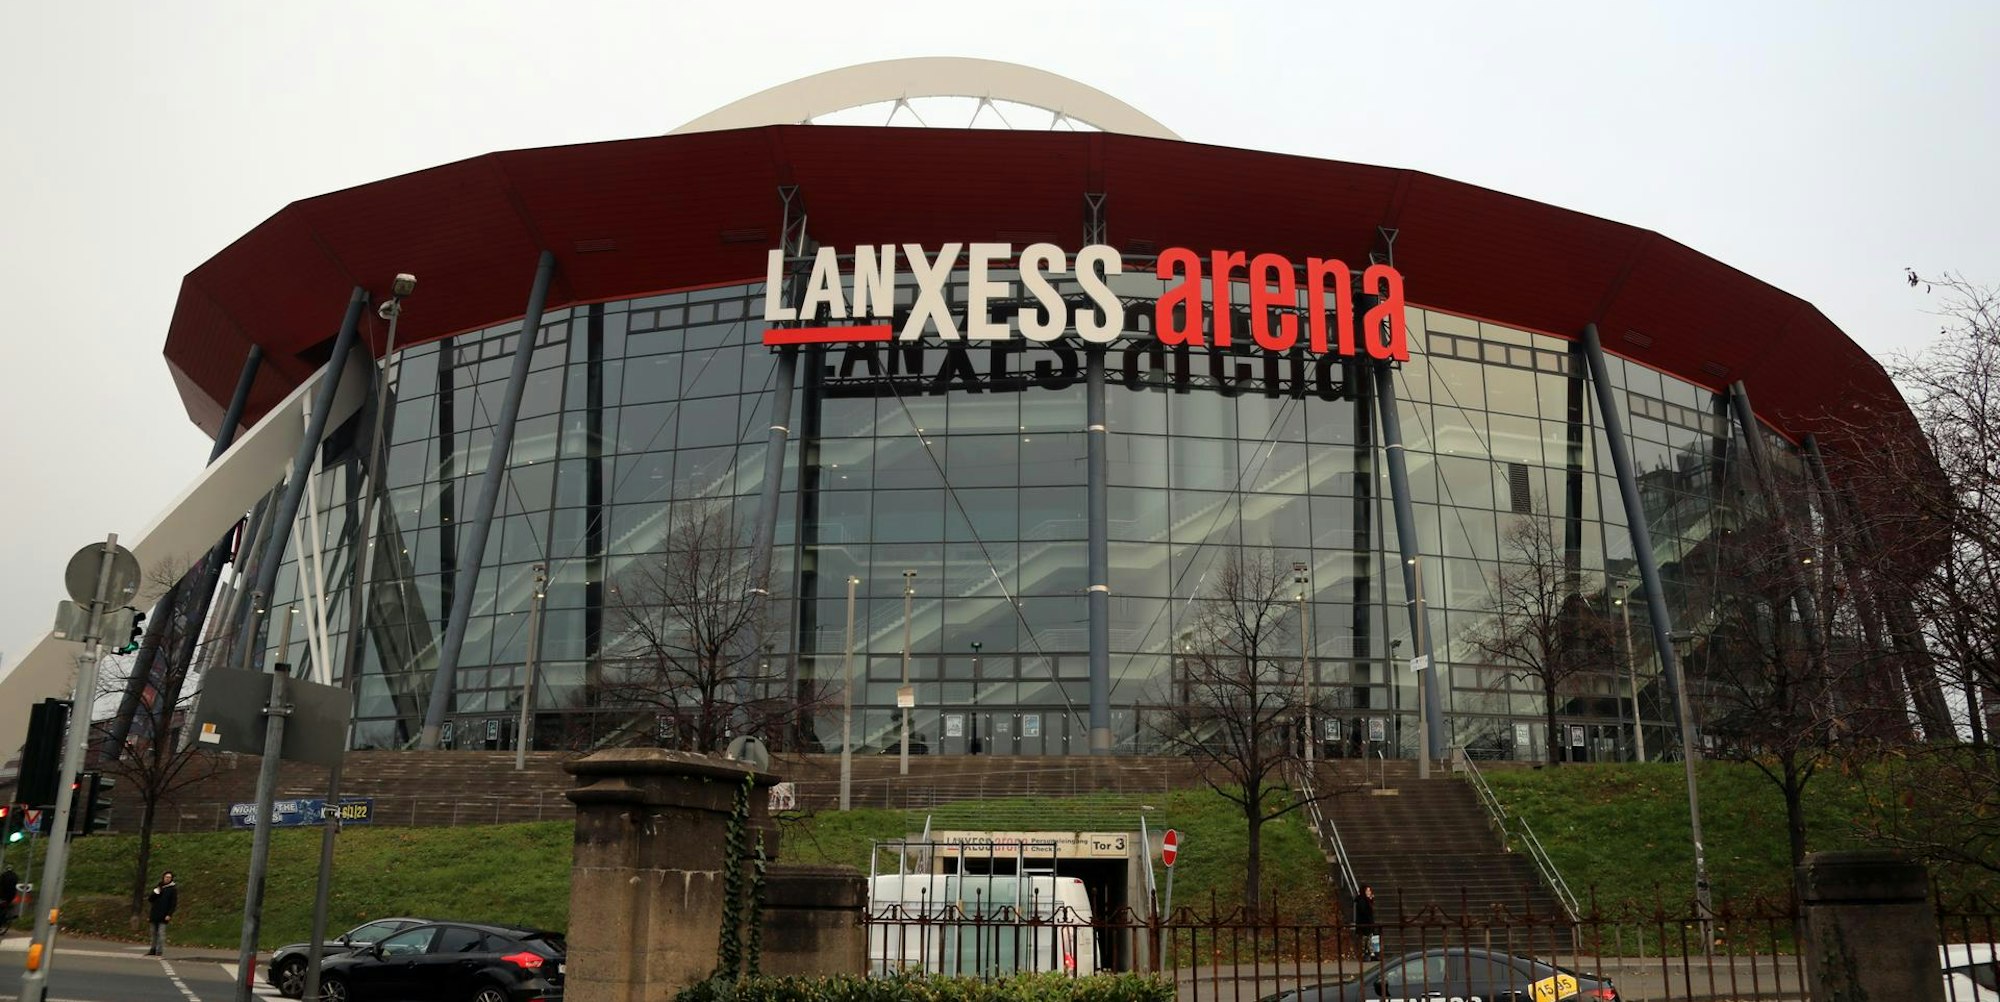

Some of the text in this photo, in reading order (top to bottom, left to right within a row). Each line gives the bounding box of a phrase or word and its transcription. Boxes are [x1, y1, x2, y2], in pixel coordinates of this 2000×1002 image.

[764, 242, 1409, 363] LANXESS arena
[278, 803, 296, 812] THE
[1093, 838, 1125, 851] Tor 3
